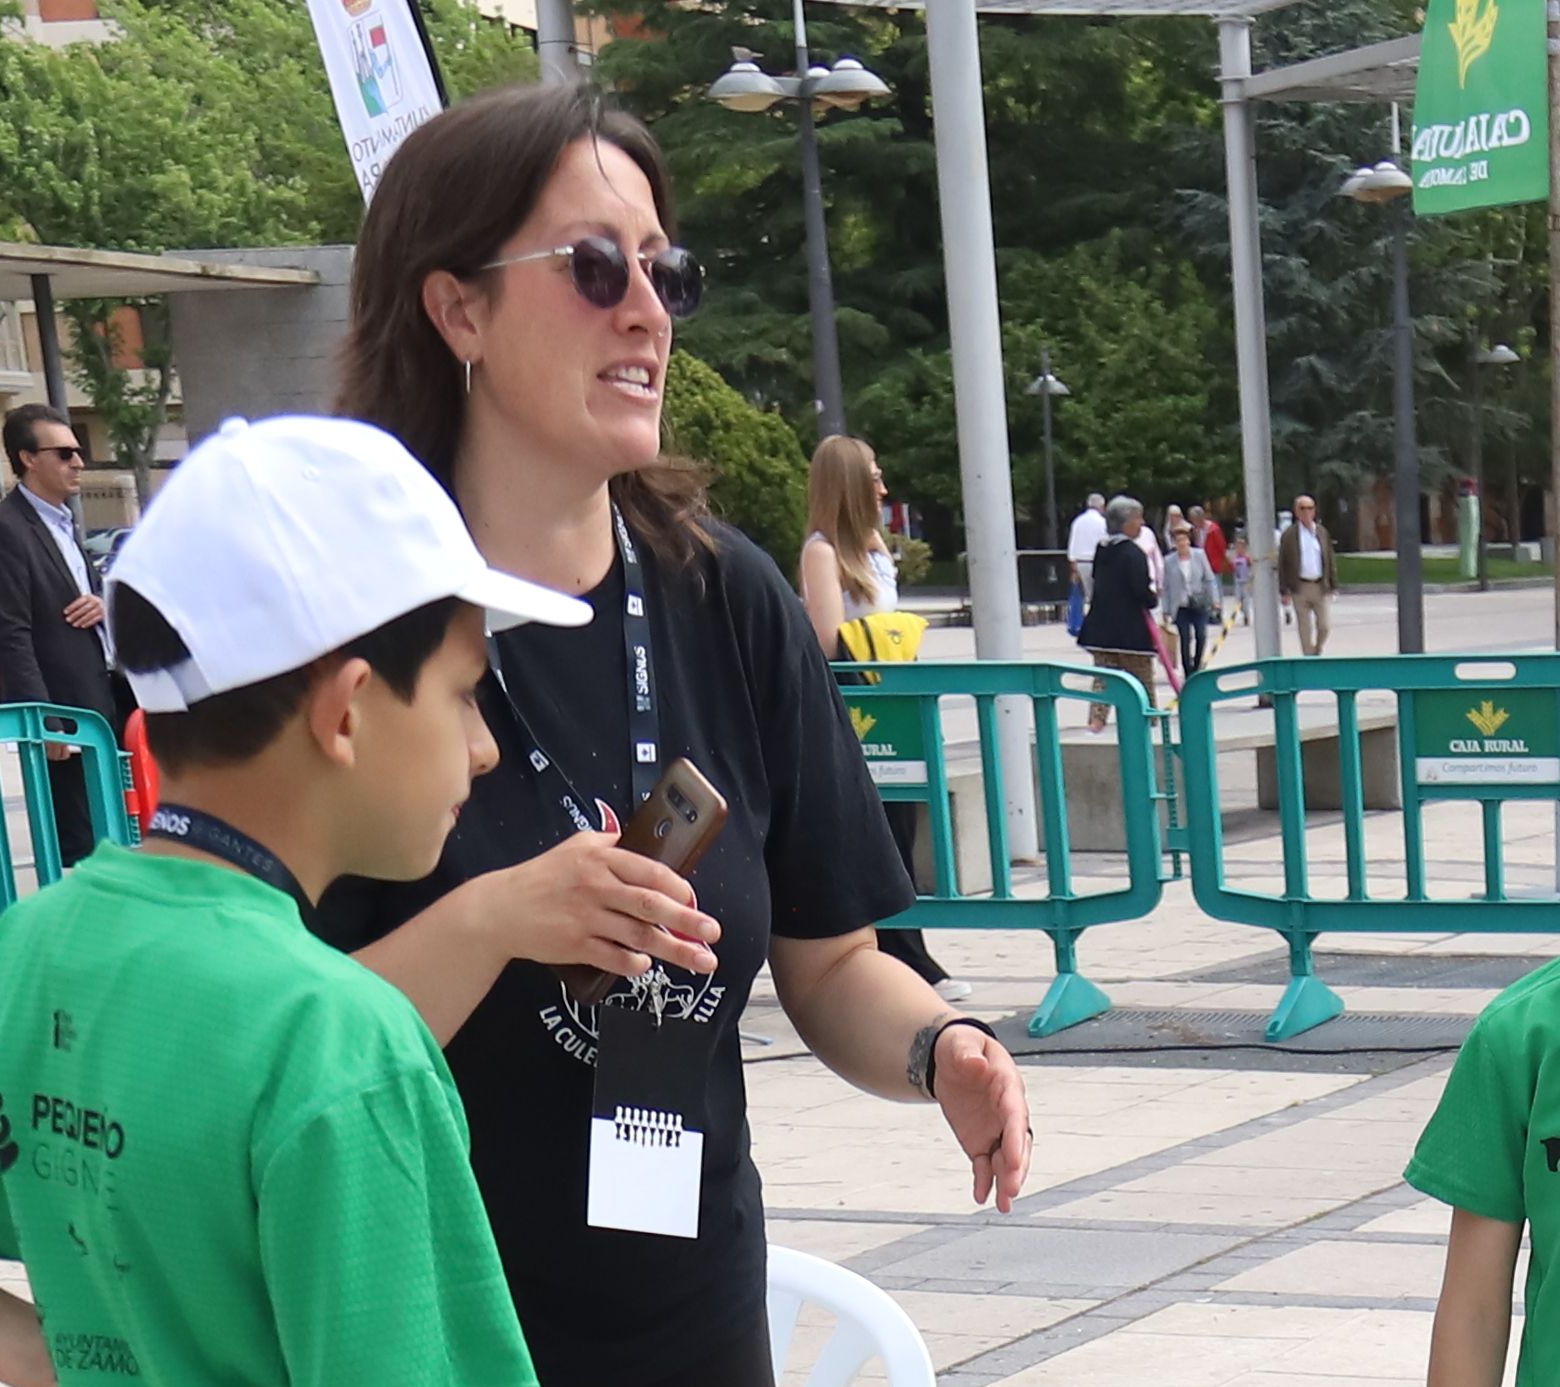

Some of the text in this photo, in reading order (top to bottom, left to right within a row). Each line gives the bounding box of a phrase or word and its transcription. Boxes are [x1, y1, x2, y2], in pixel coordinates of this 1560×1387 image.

[634, 645, 650, 696] SIGNUS
[861, 743, 897, 756] URAL
[1449, 739, 1529, 753] CAJA RURAL
[1442, 761, 1538, 776] Compartimos futuro
[538, 1005, 600, 1069] LA CULE
[55, 1349, 140, 1376] DE ZAMO
